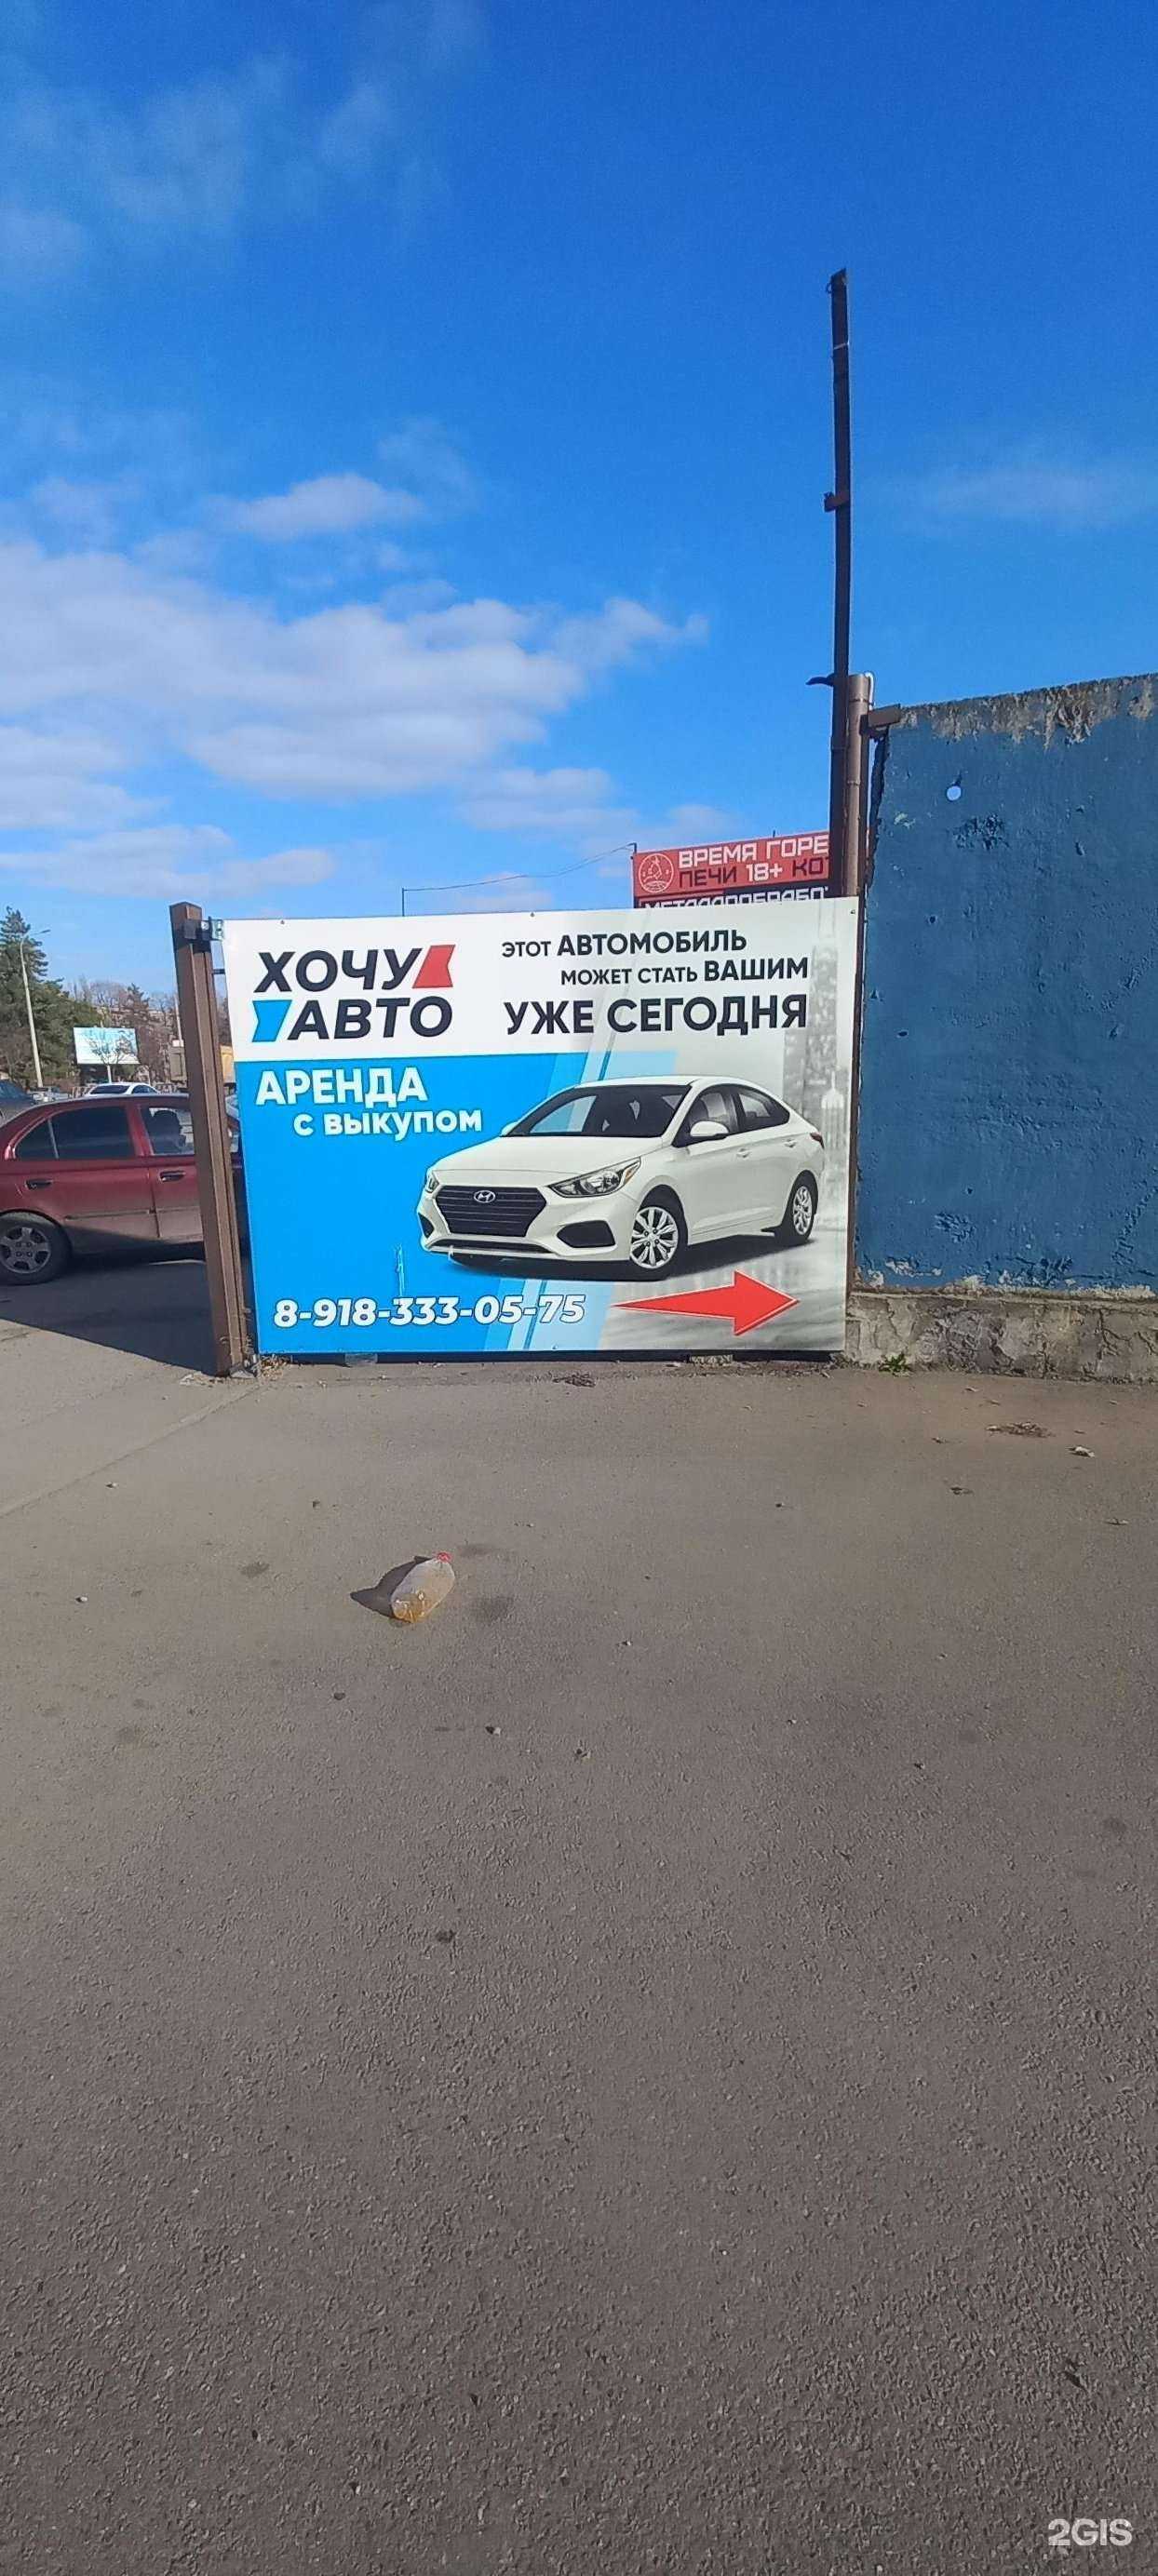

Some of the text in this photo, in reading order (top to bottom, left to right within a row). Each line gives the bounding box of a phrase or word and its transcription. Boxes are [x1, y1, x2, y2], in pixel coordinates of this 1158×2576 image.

[679, 843, 757, 869] ВРЕМЯ
[679, 856, 829, 888] ПЕЧИ 18+ КО
[502, 930, 747, 958] ЭТОТ АВТОМОБИЛЬ
[253, 947, 423, 994] ХОЧУ
[560, 957, 809, 986] МОЖЕТ СТАТЬ ВАШИМ
[287, 996, 454, 1041] АВТО
[504, 994, 808, 1036] УЖЕ СЕГОДНЯ
[254, 1066, 429, 1110] АРЕНДА
[323, 1108, 483, 1143] выкупом
[273, 1295, 586, 1328] 8-918-333-05-75
